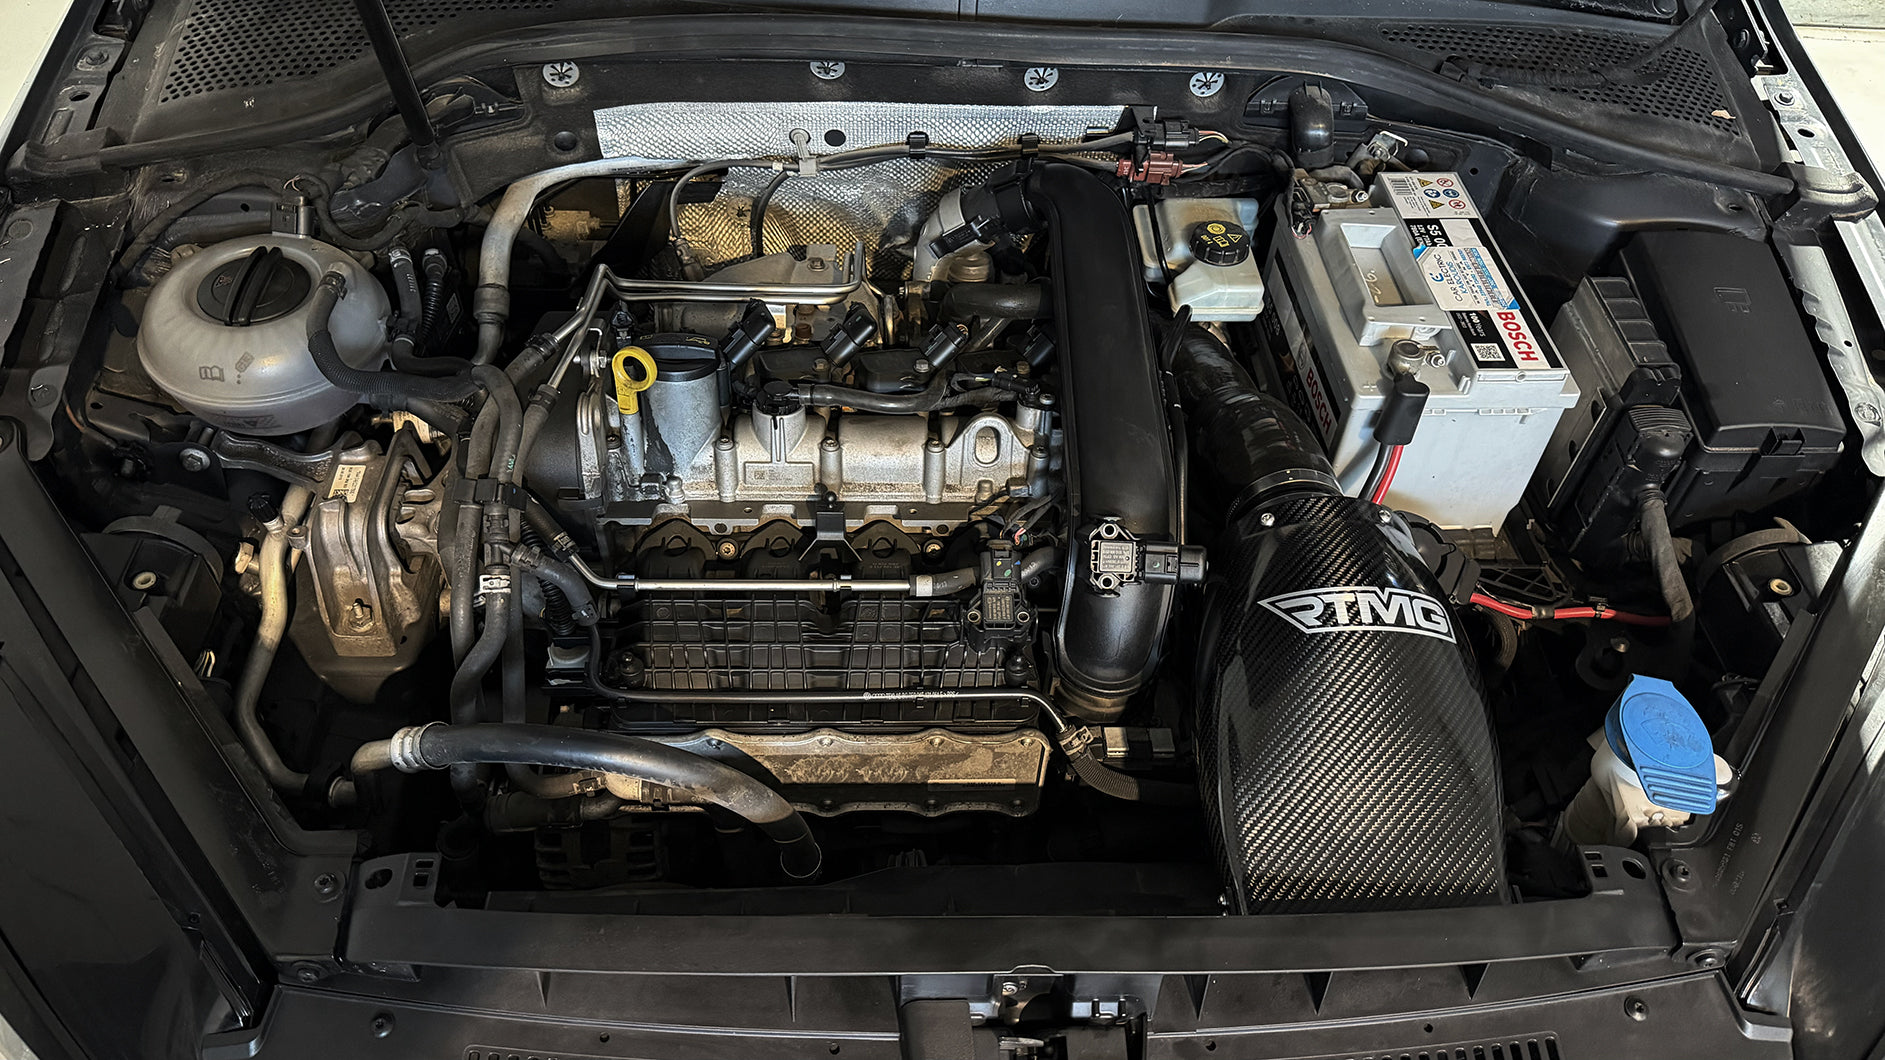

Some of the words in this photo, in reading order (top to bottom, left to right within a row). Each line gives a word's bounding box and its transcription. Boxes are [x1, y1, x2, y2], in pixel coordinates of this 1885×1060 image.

[1427, 224, 1442, 236] S5
[1433, 253, 1455, 285] ELECTRIC
[1445, 261, 1468, 294] KAROUDIS
[1449, 286, 1464, 302] CAR
[1469, 312, 1480, 324] 100
[1474, 322, 1487, 337] Years
[1496, 311, 1539, 361] BOSCH
[1306, 366, 1332, 435] BOSCH
[1274, 591, 1449, 635] RTMG
